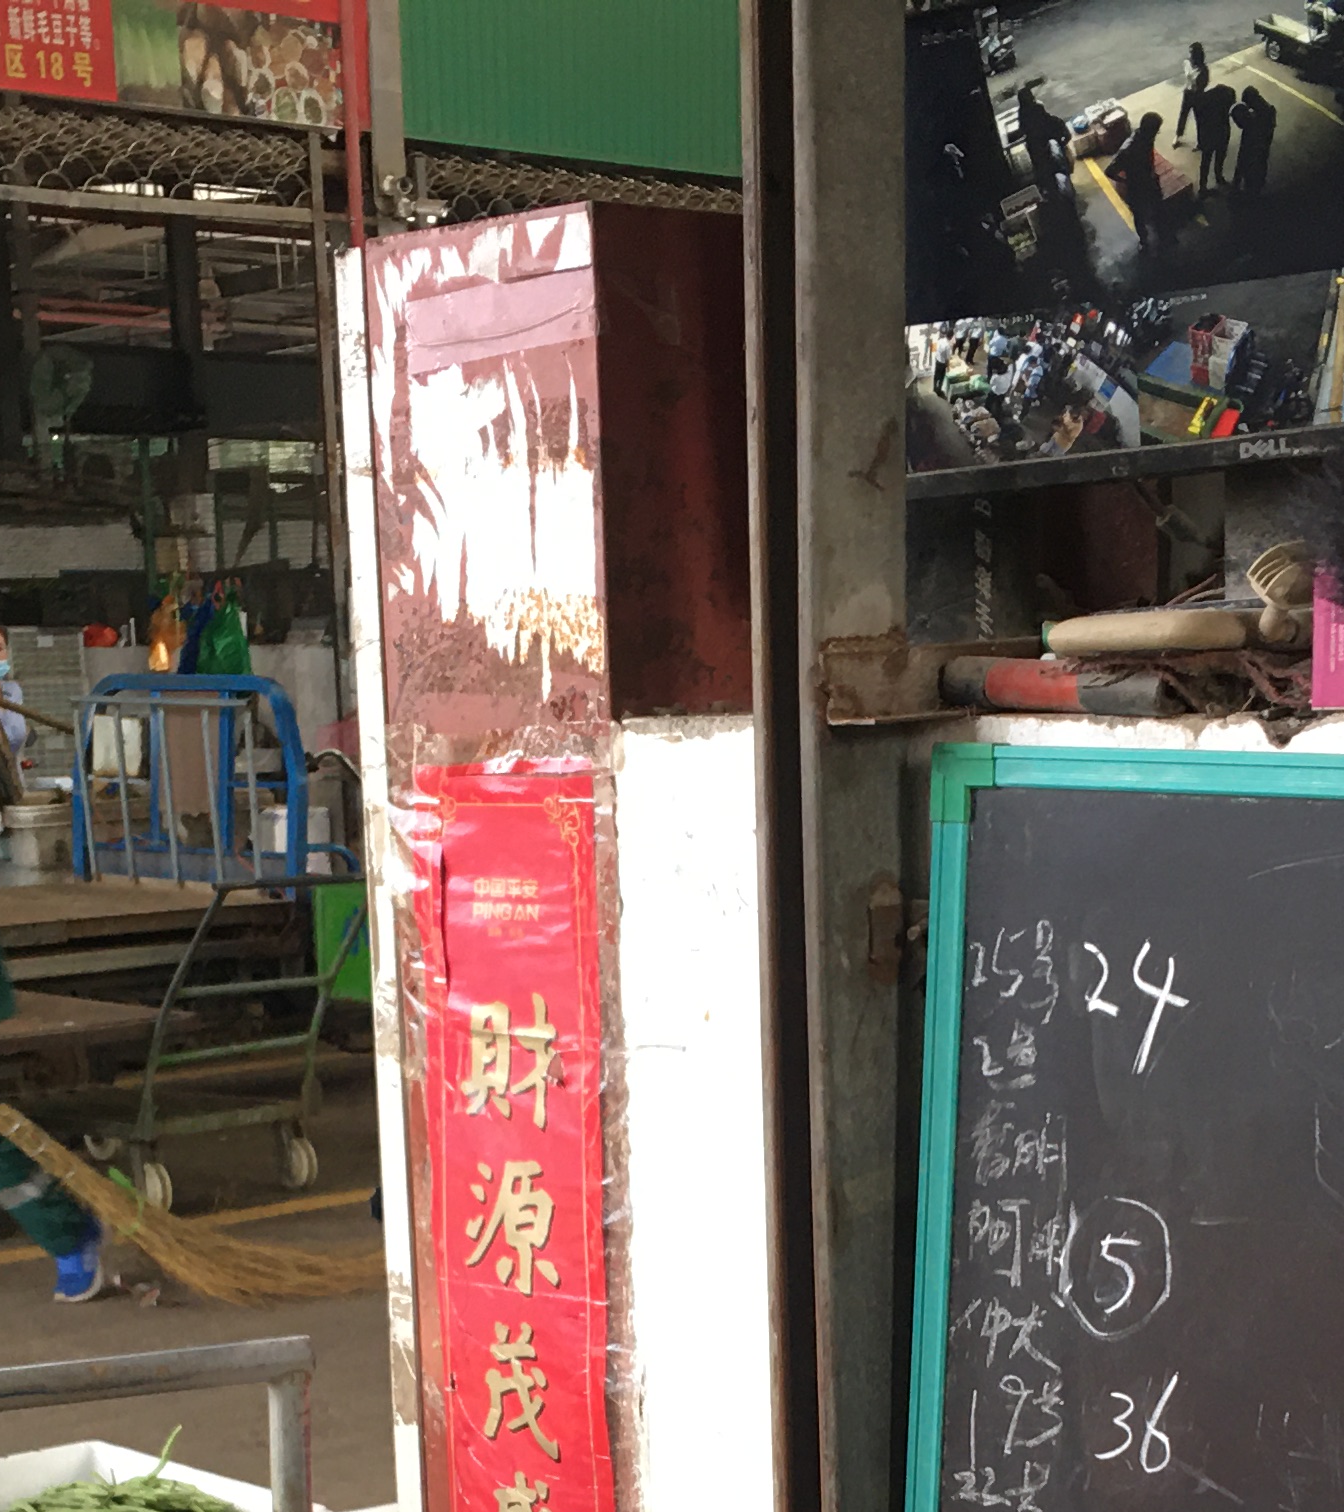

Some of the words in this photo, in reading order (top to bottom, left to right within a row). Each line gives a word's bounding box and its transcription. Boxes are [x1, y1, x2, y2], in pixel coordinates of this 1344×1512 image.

[1239, 436, 1294, 460] DELL
[473, 877, 539, 899] 中国平安
[1083, 937, 1190, 1075] 24
[1094, 1372, 1179, 1473] 36
